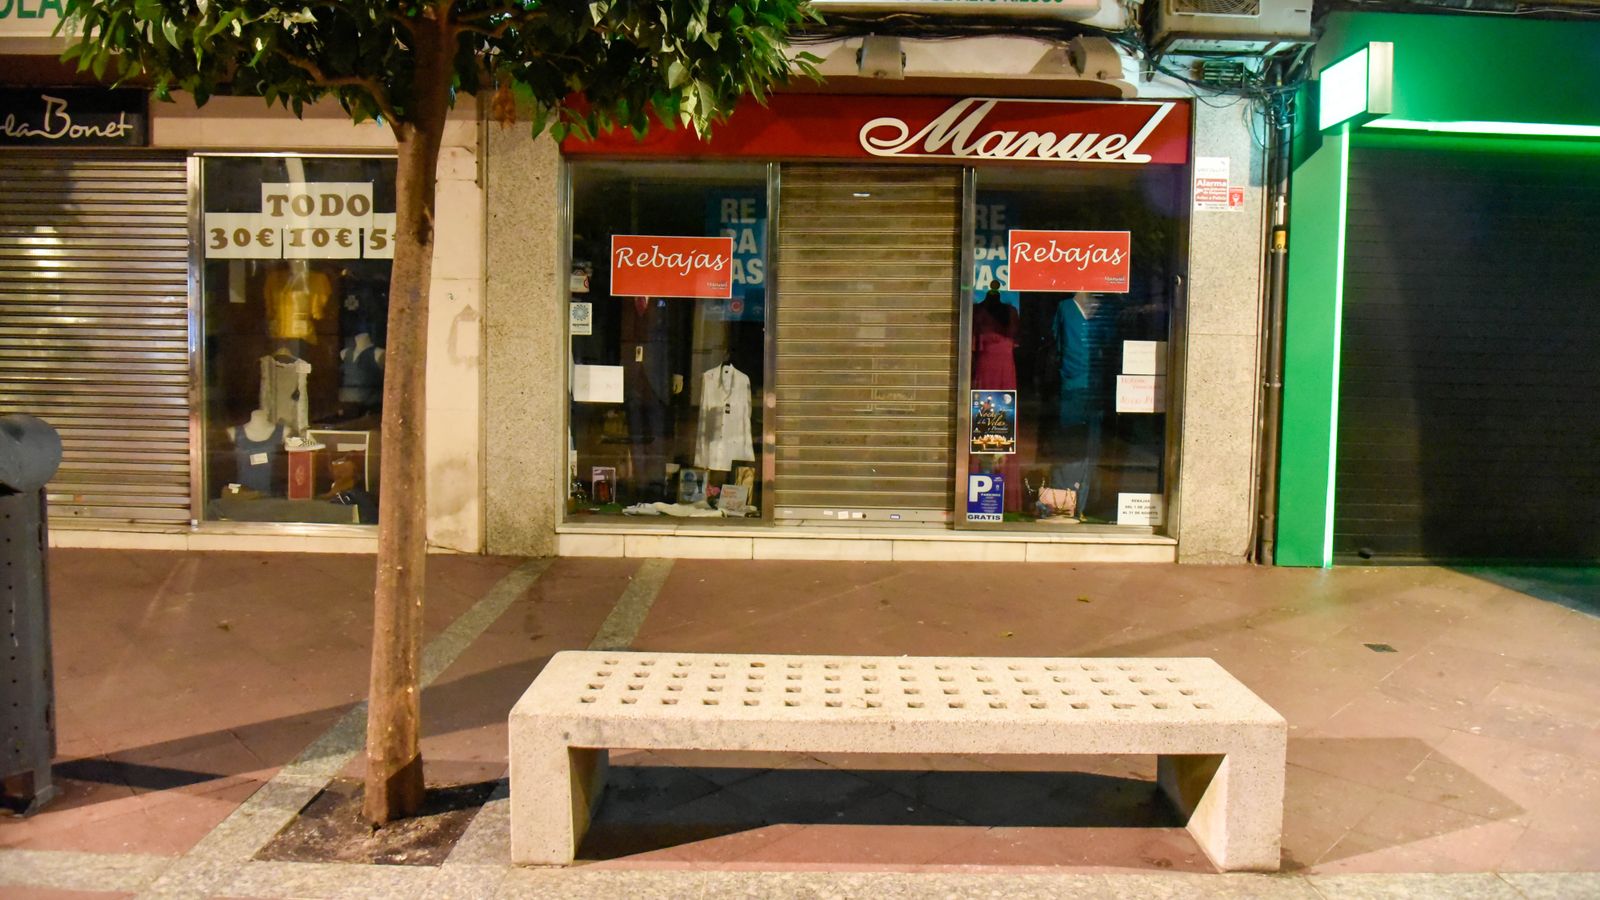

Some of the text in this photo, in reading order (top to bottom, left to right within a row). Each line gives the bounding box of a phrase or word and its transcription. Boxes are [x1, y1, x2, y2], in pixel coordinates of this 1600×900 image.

[41, 94, 133, 139] Bonet
[859, 98, 1177, 164] Manuel
[266, 193, 371, 217] TODO
[720, 198, 757, 224] RE
[209, 228, 274, 250] 30€
[288, 228, 353, 248] 10€
[369, 228, 397, 250] 5
[615, 245, 730, 276] Rebajas
[1012, 239, 1127, 271] Rebajas
[732, 258, 764, 285] AS
[973, 264, 1009, 290] AS
[969, 475, 993, 502] P
